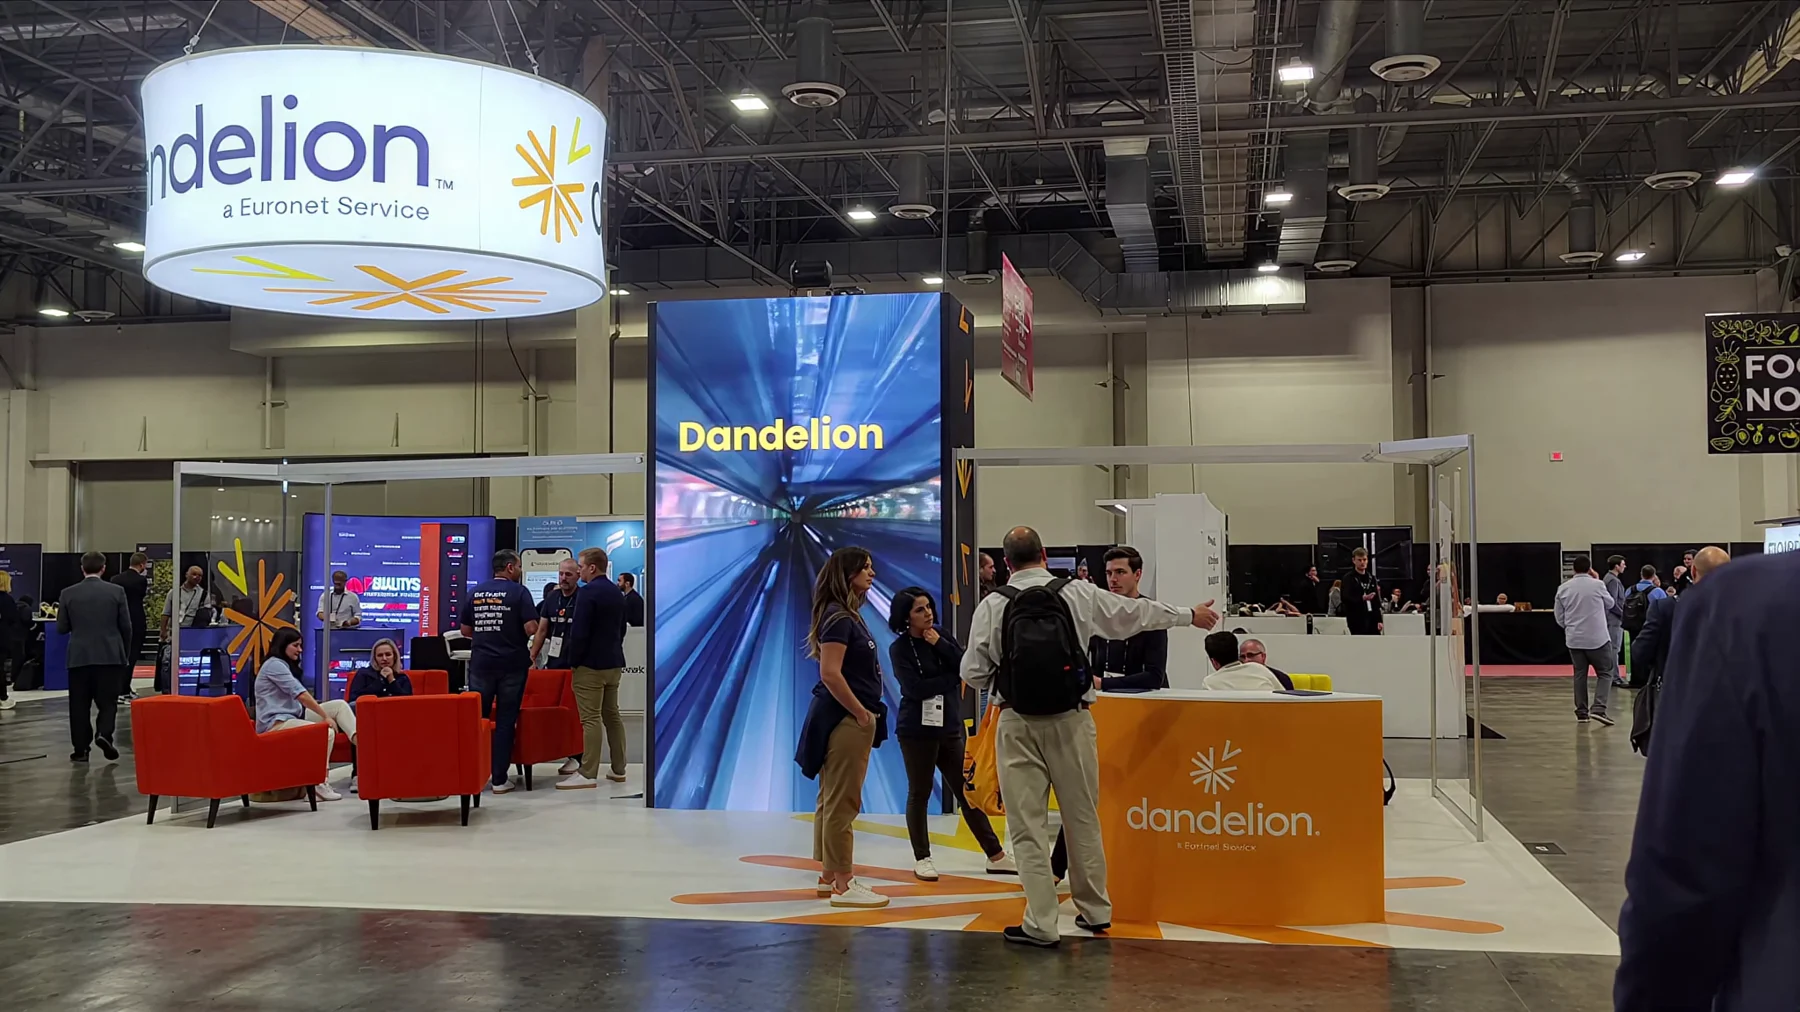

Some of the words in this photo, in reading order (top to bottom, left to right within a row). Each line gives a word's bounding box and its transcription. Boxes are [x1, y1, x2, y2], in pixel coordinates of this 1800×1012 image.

[223, 204, 234, 219] a
[240, 197, 329, 217] Euronet
[337, 196, 430, 221] Service
[1745, 354, 1800, 379] FO
[679, 415, 884, 452] Dandelion
